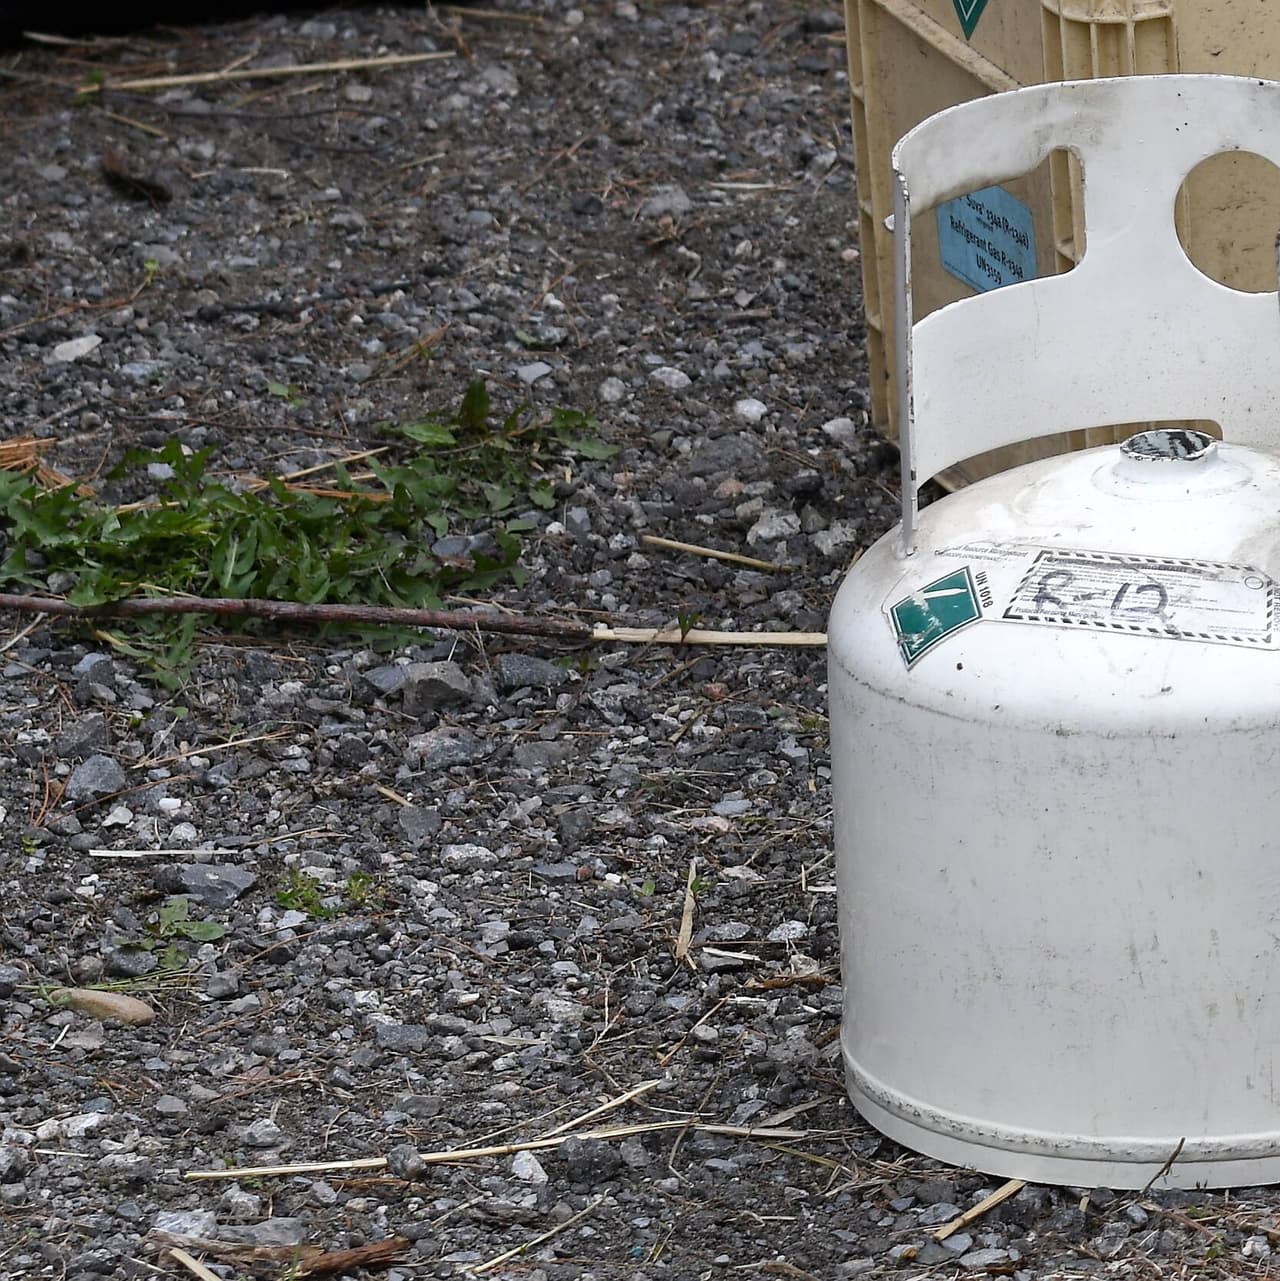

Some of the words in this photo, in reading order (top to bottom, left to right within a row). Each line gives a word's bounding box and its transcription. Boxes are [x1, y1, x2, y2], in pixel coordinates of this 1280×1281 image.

[950, 215, 987, 253] Refrigerant
[987, 241, 1001, 262] Gas
[975, 570, 988, 587] UN
[1032, 568, 1169, 619] R-12
[979, 586, 994, 609] 1018
